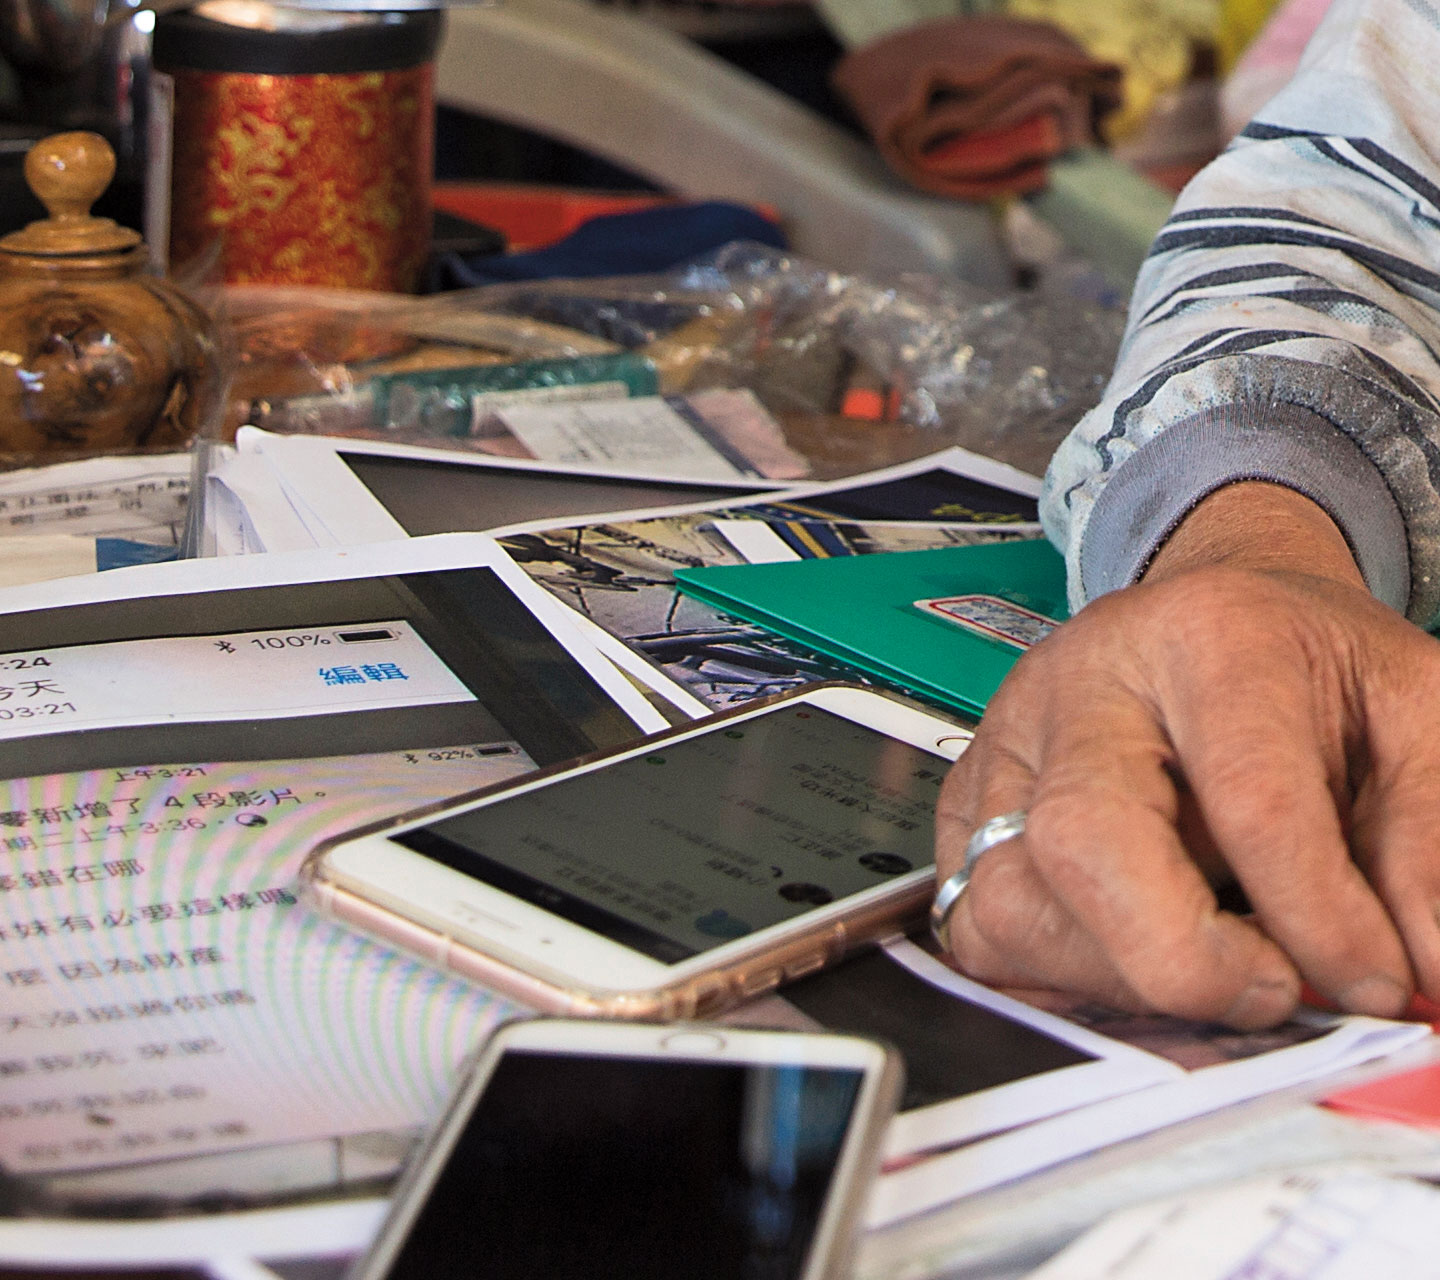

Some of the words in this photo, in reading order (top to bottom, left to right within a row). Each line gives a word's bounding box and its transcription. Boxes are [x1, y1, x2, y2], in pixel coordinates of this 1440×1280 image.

[252, 634, 331, 651] 100%
[318, 662, 409, 686] 編輯
[427, 749, 473, 762] 92%
